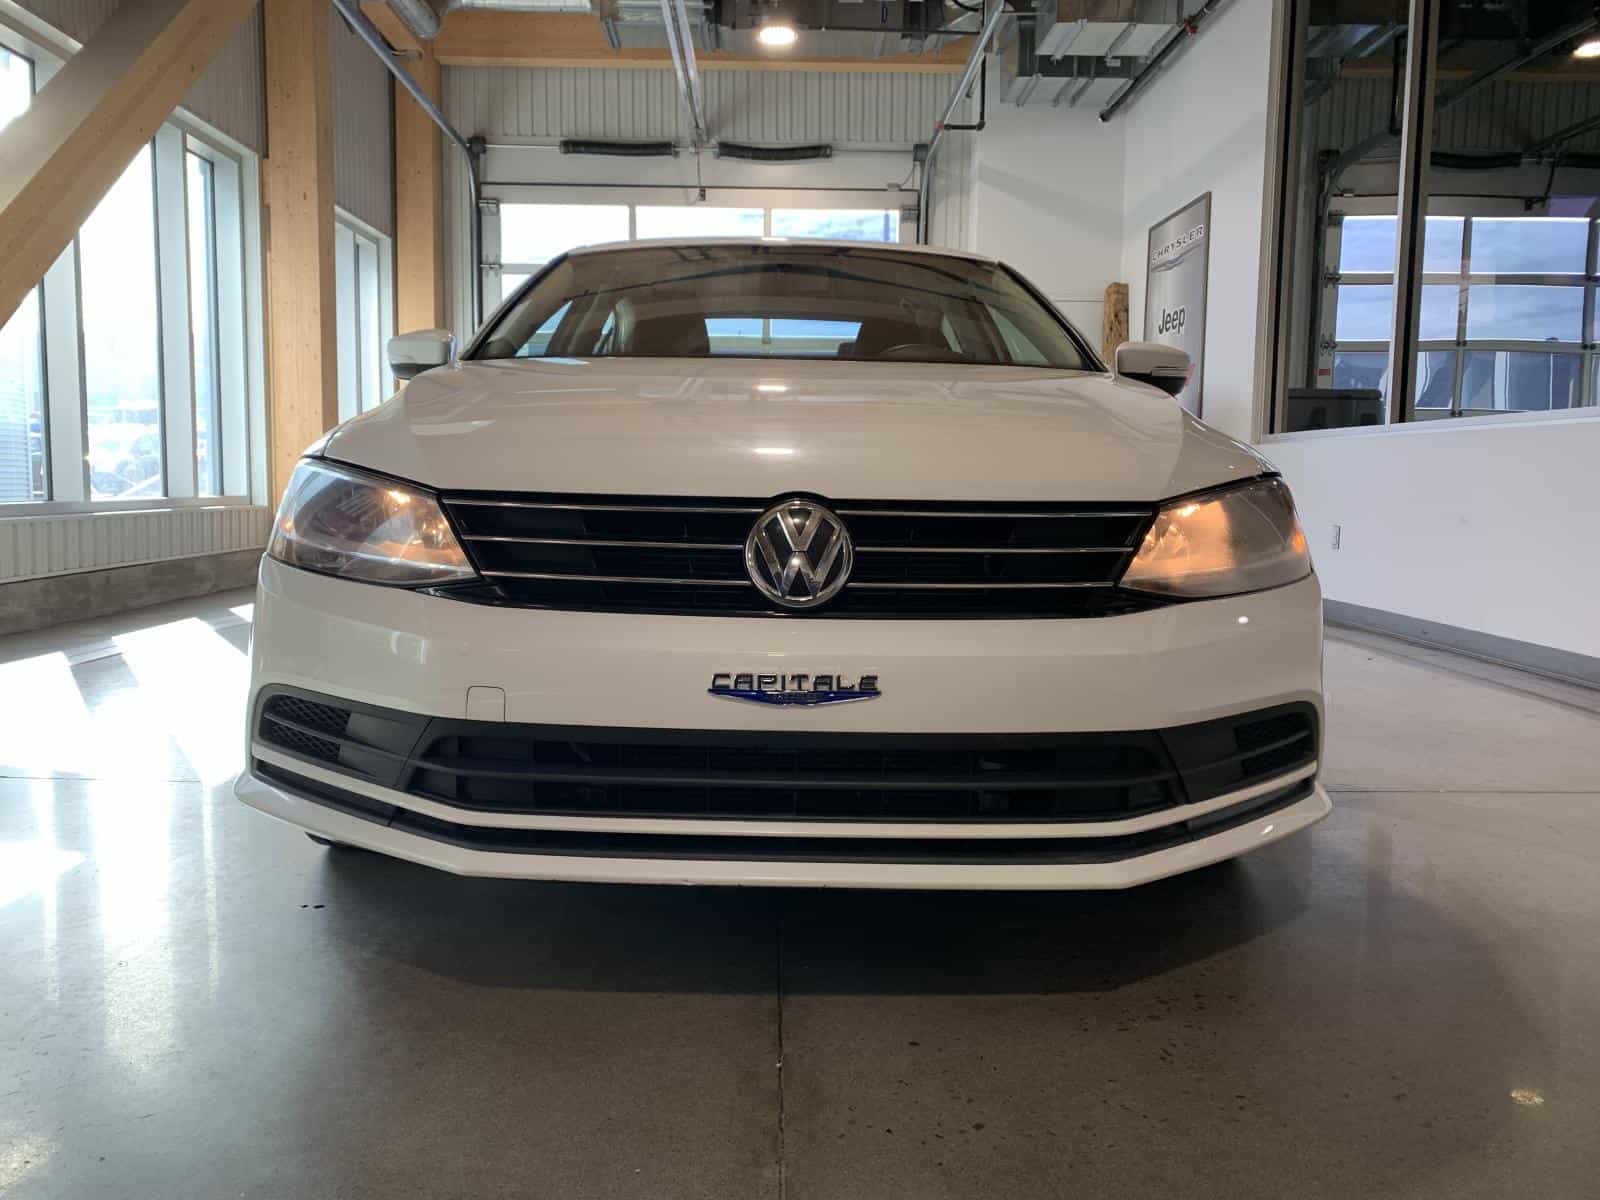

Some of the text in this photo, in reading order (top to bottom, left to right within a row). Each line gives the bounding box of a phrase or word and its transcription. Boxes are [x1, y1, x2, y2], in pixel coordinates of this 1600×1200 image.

[1152, 225, 1204, 261] CHRYSLER
[1158, 306, 1186, 335] Jeep
[749, 502, 849, 603] VW
[711, 672, 878, 692] CAPITALE
